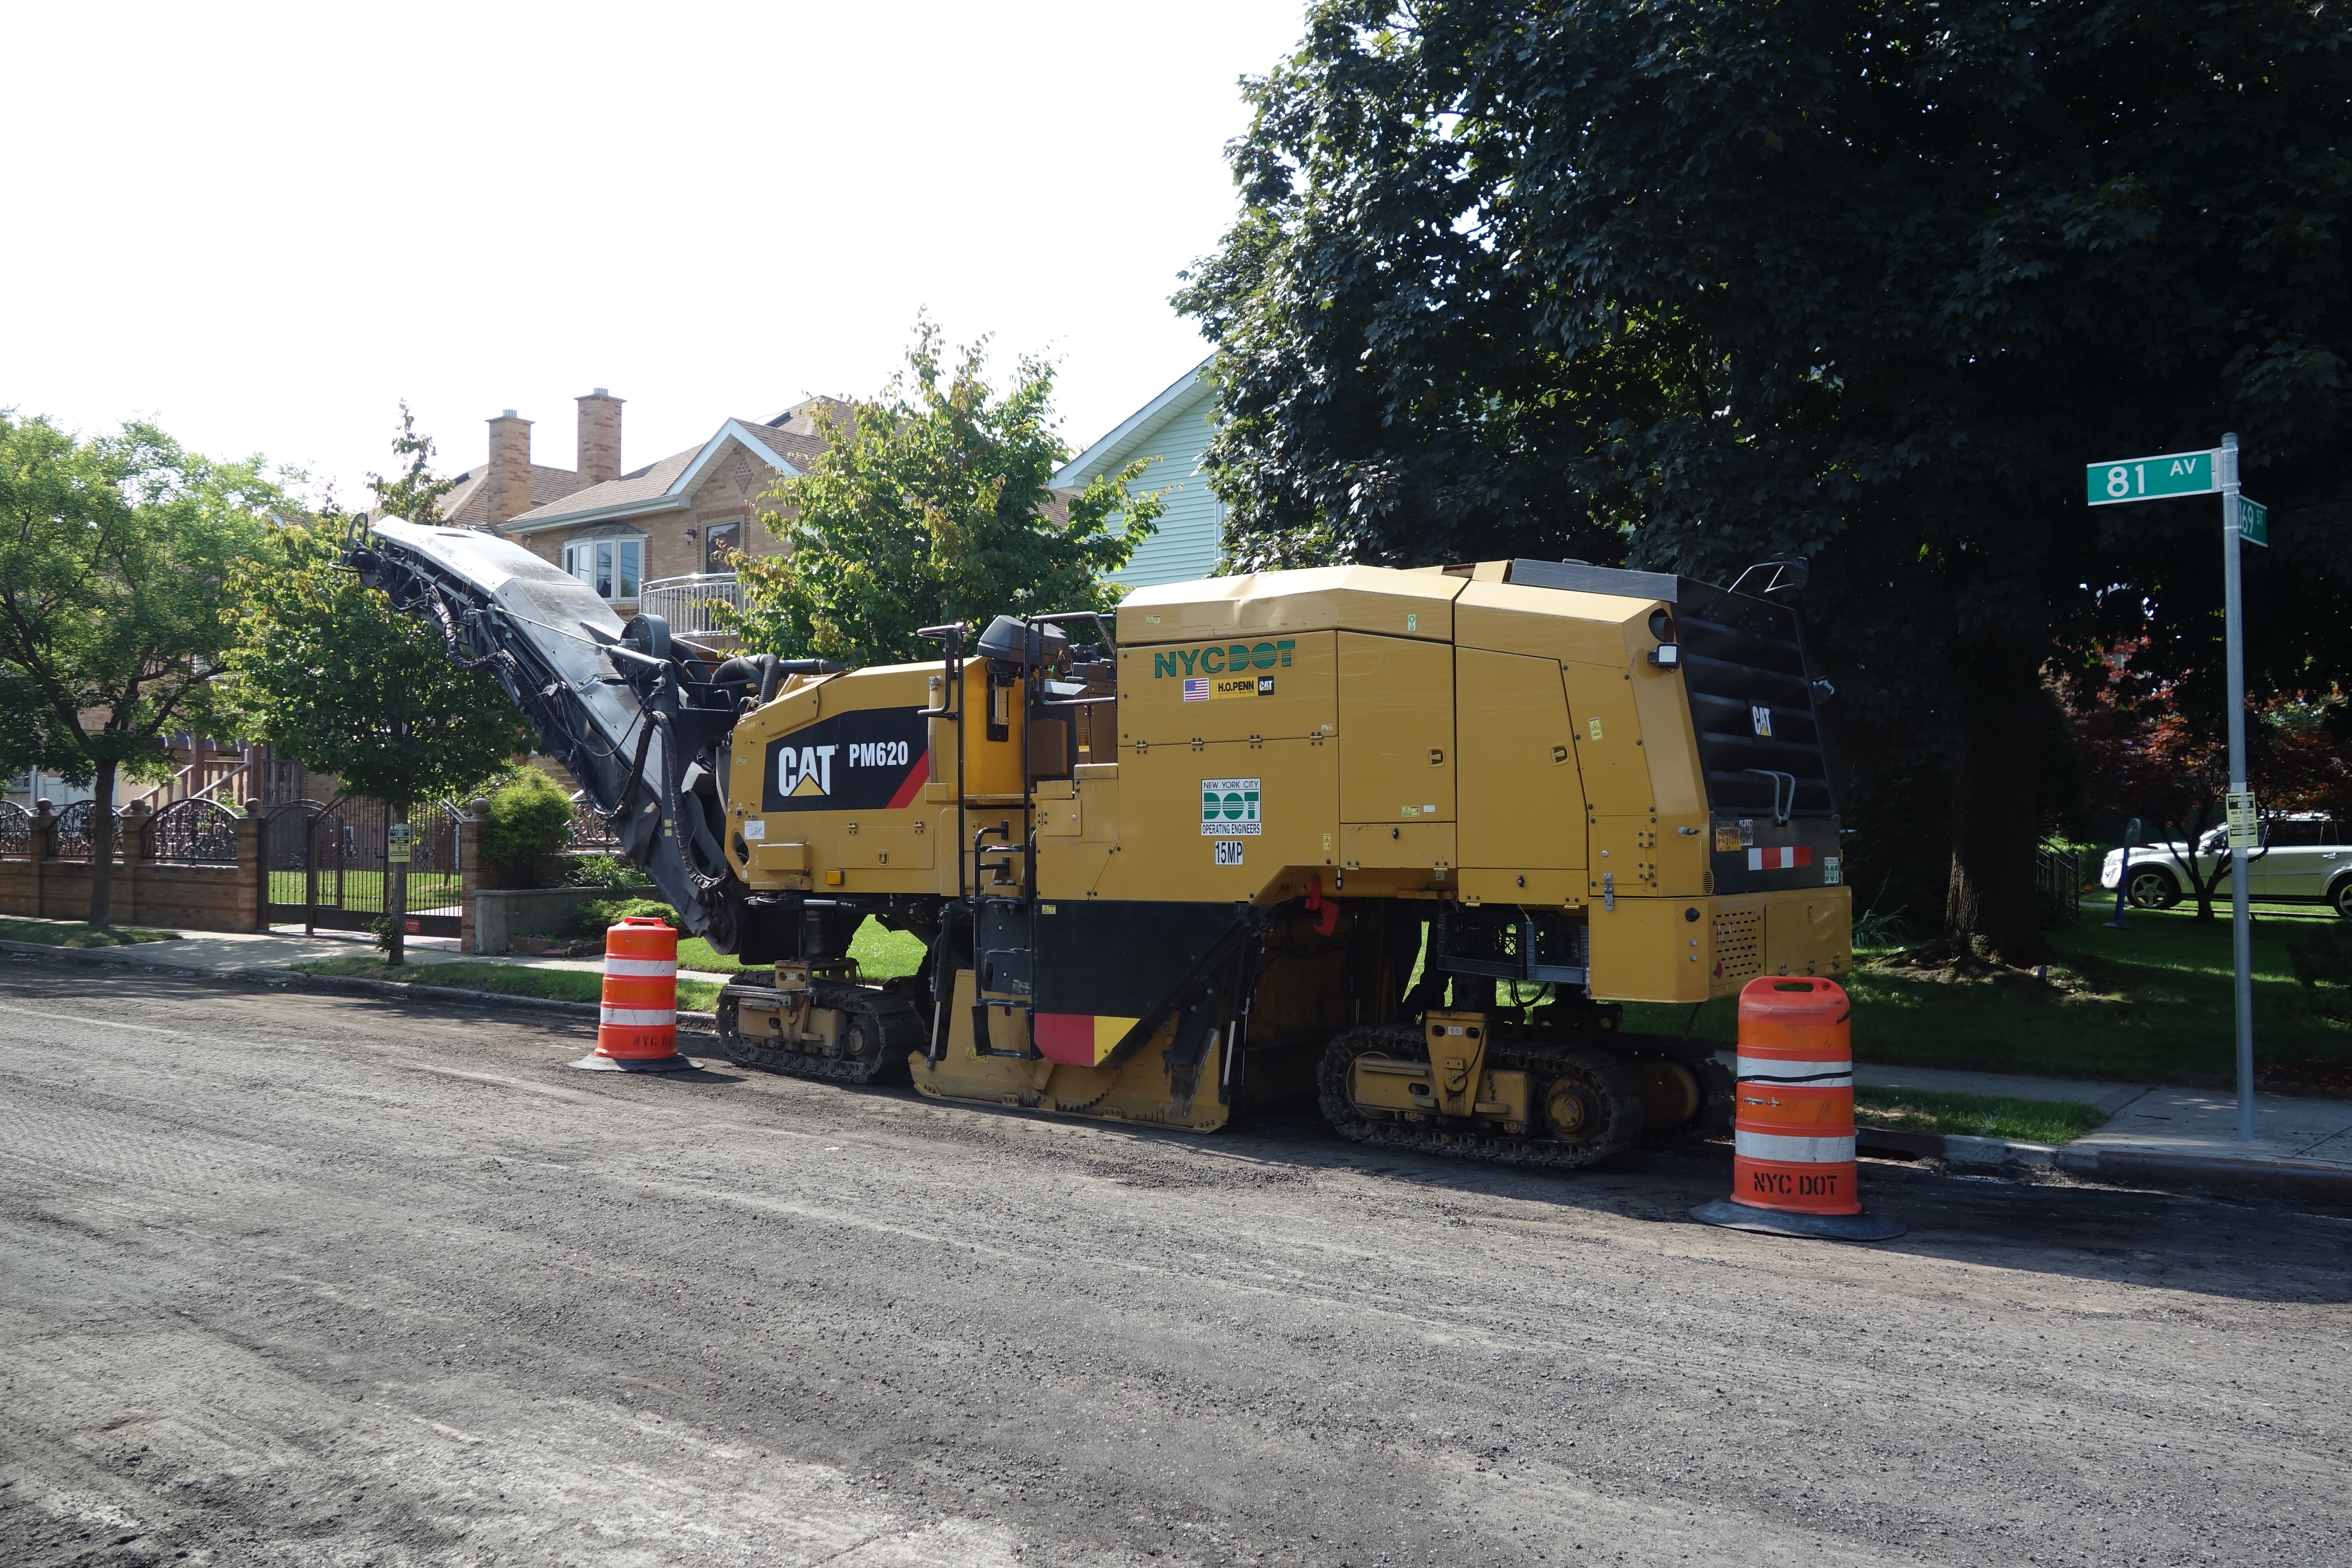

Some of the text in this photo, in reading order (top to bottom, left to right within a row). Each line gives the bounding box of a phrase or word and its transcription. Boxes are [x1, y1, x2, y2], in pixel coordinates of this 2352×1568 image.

[2107, 458, 2197, 497] 81 AV
[2256, 509, 2263, 526] ST
[1218, 680, 1254, 692] H.O.PENN
[1259, 680, 1273, 691] CAT
[1752, 706, 1772, 736] CAT
[778, 741, 908, 796] CAT PM620
[1204, 792, 1259, 820] DOT
[1202, 824, 1260, 835] OPERATING ENGINEERS
[1215, 842, 1243, 864] 15MP
[633, 1035, 675, 1046] NYC DO
[1754, 1172, 1838, 1195] NYC DOT
